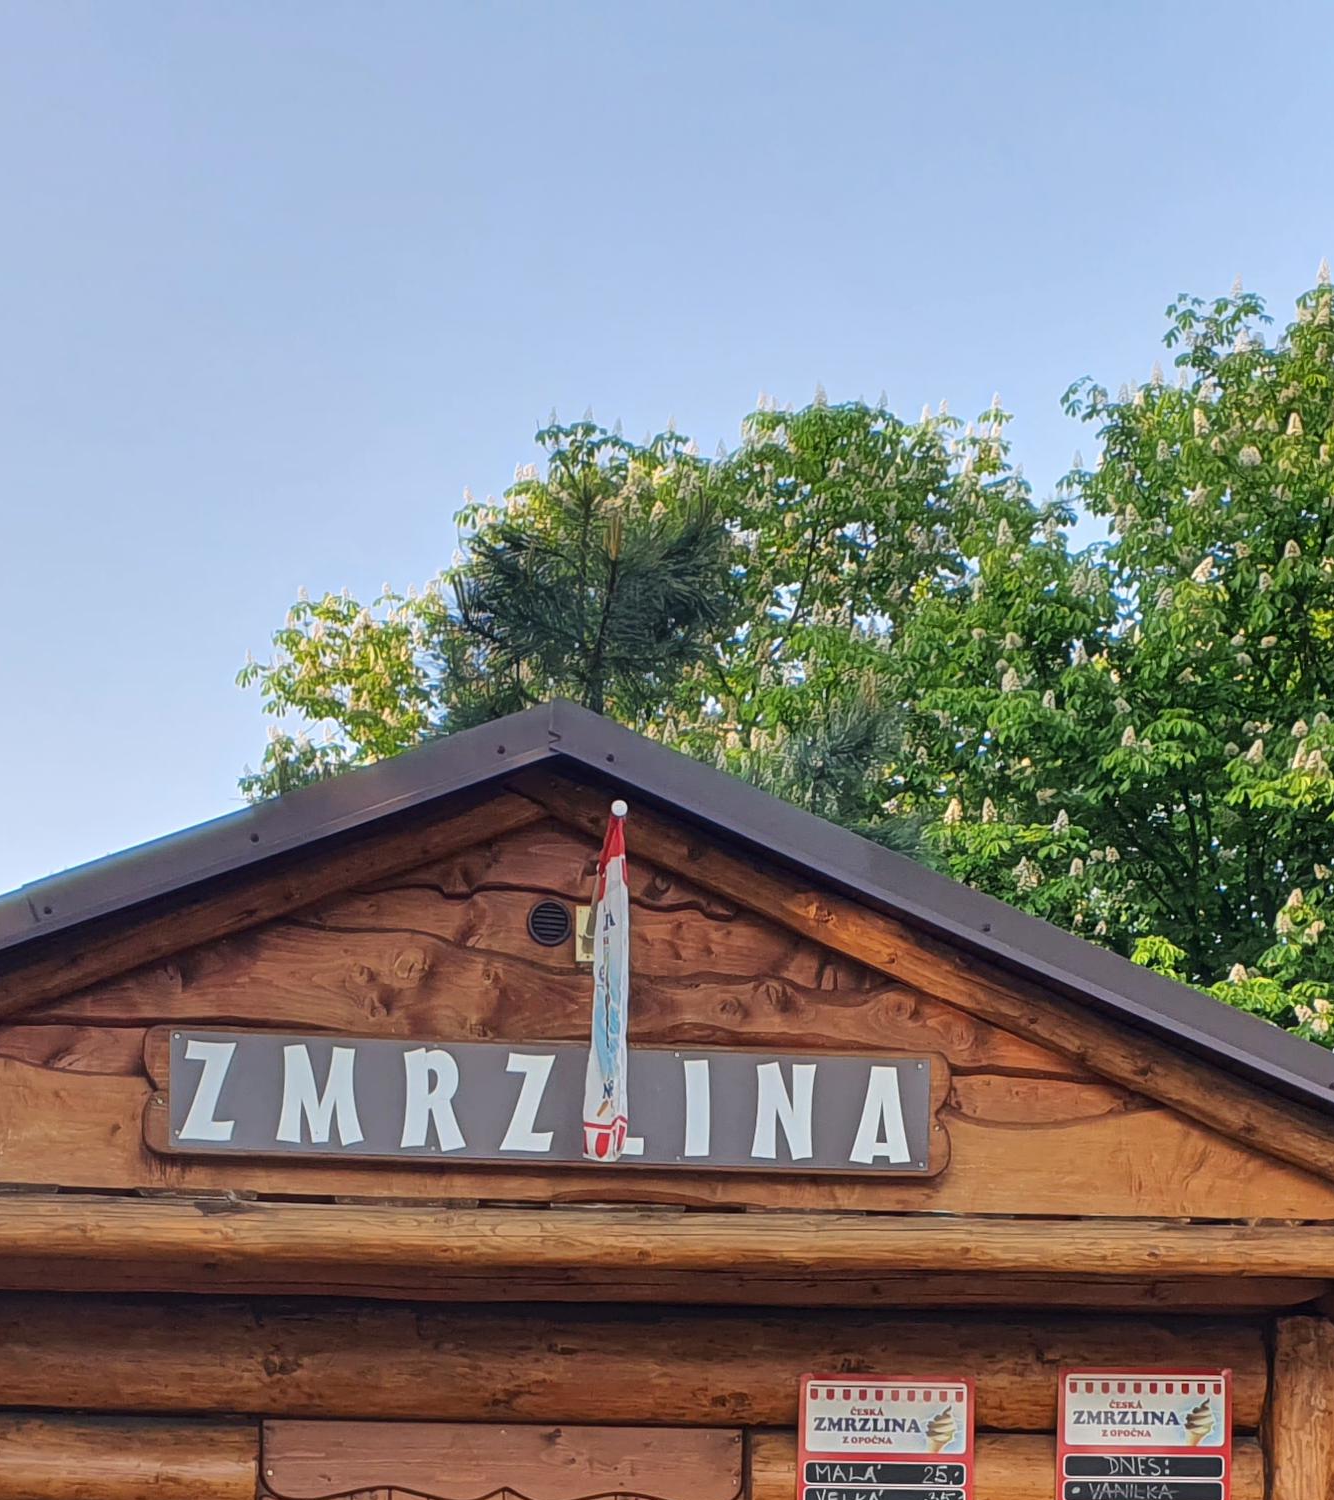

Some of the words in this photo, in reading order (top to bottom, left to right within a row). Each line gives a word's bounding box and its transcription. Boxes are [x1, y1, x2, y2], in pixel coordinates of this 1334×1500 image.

[178, 1039, 911, 1164] ZMRZINA
[850, 1406, 884, 1416] ČESKÁ
[1109, 1399, 1143, 1409] ČESKÁ
[813, 1416, 921, 1433] ZMRZLINA
[1073, 1410, 1181, 1426] ZMRZLINA
[842, 1436, 849, 1444] Z
[851, 1435, 893, 1445] OPOČNA
[1110, 1428, 1152, 1438] OPOČNA
[815, 1463, 882, 1483] MALÁ
[1104, 1456, 1170, 1475] DNES:
[1088, 1482, 1178, 1500] VANILKA
